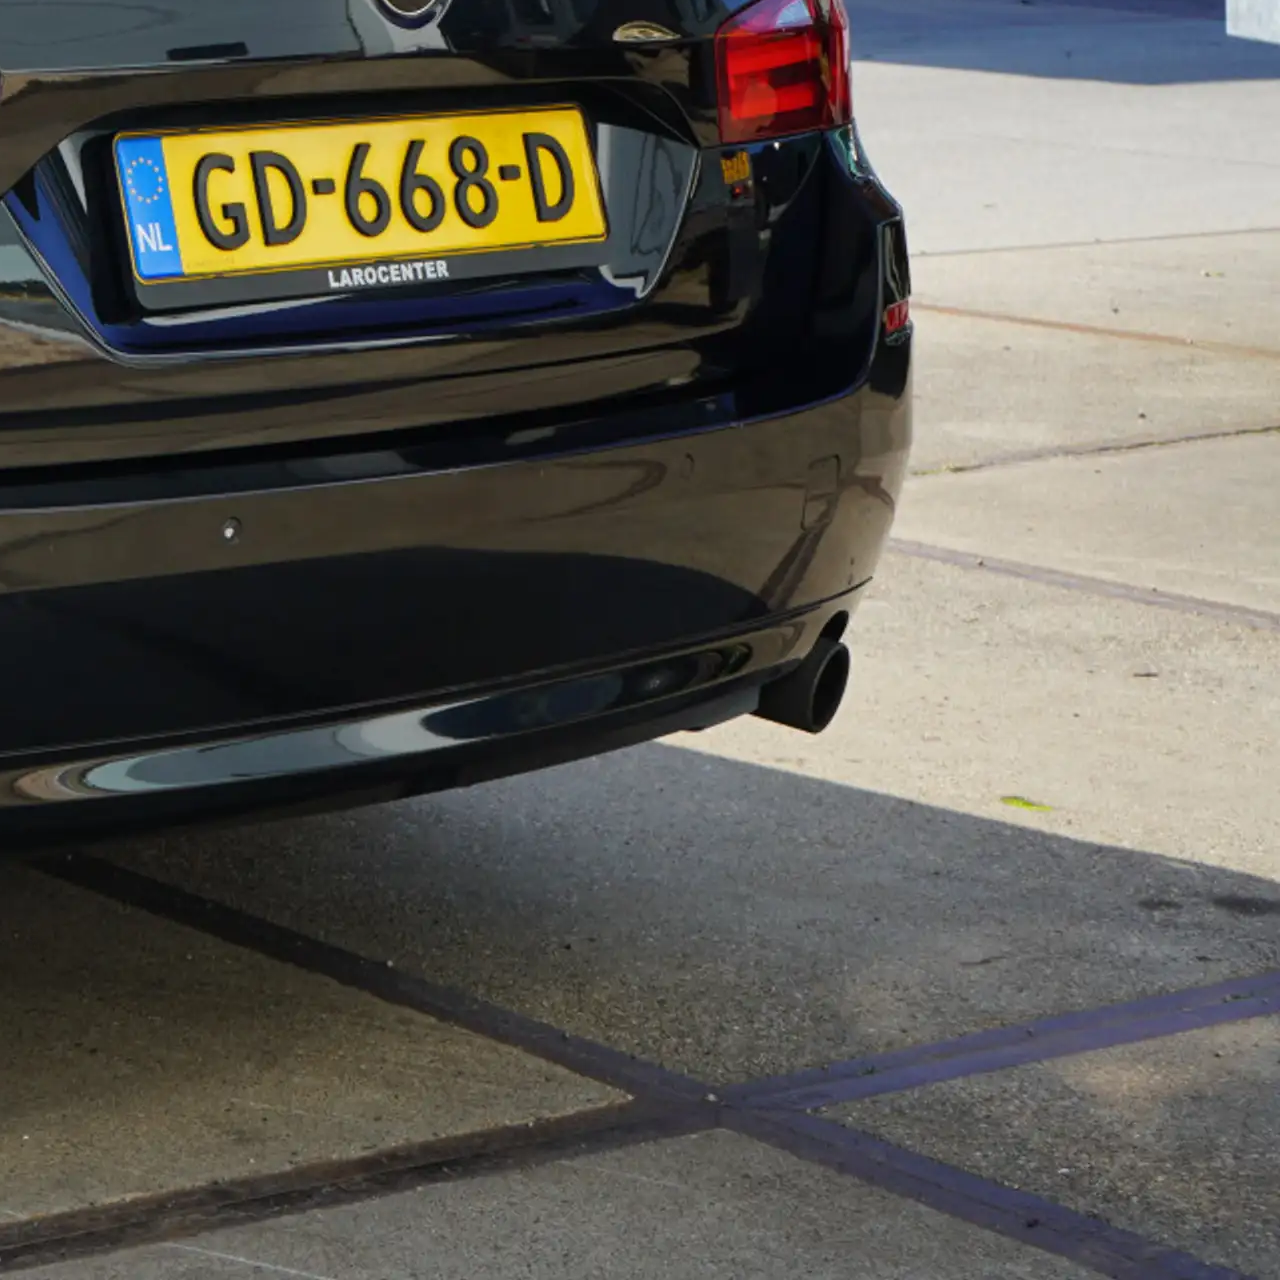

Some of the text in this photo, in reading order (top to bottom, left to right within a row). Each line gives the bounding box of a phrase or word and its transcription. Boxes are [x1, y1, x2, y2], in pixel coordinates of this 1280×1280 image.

[191, 131, 575, 251] GD-668-D
[135, 223, 173, 253] NL
[327, 260, 450, 289] LAROCENTER
